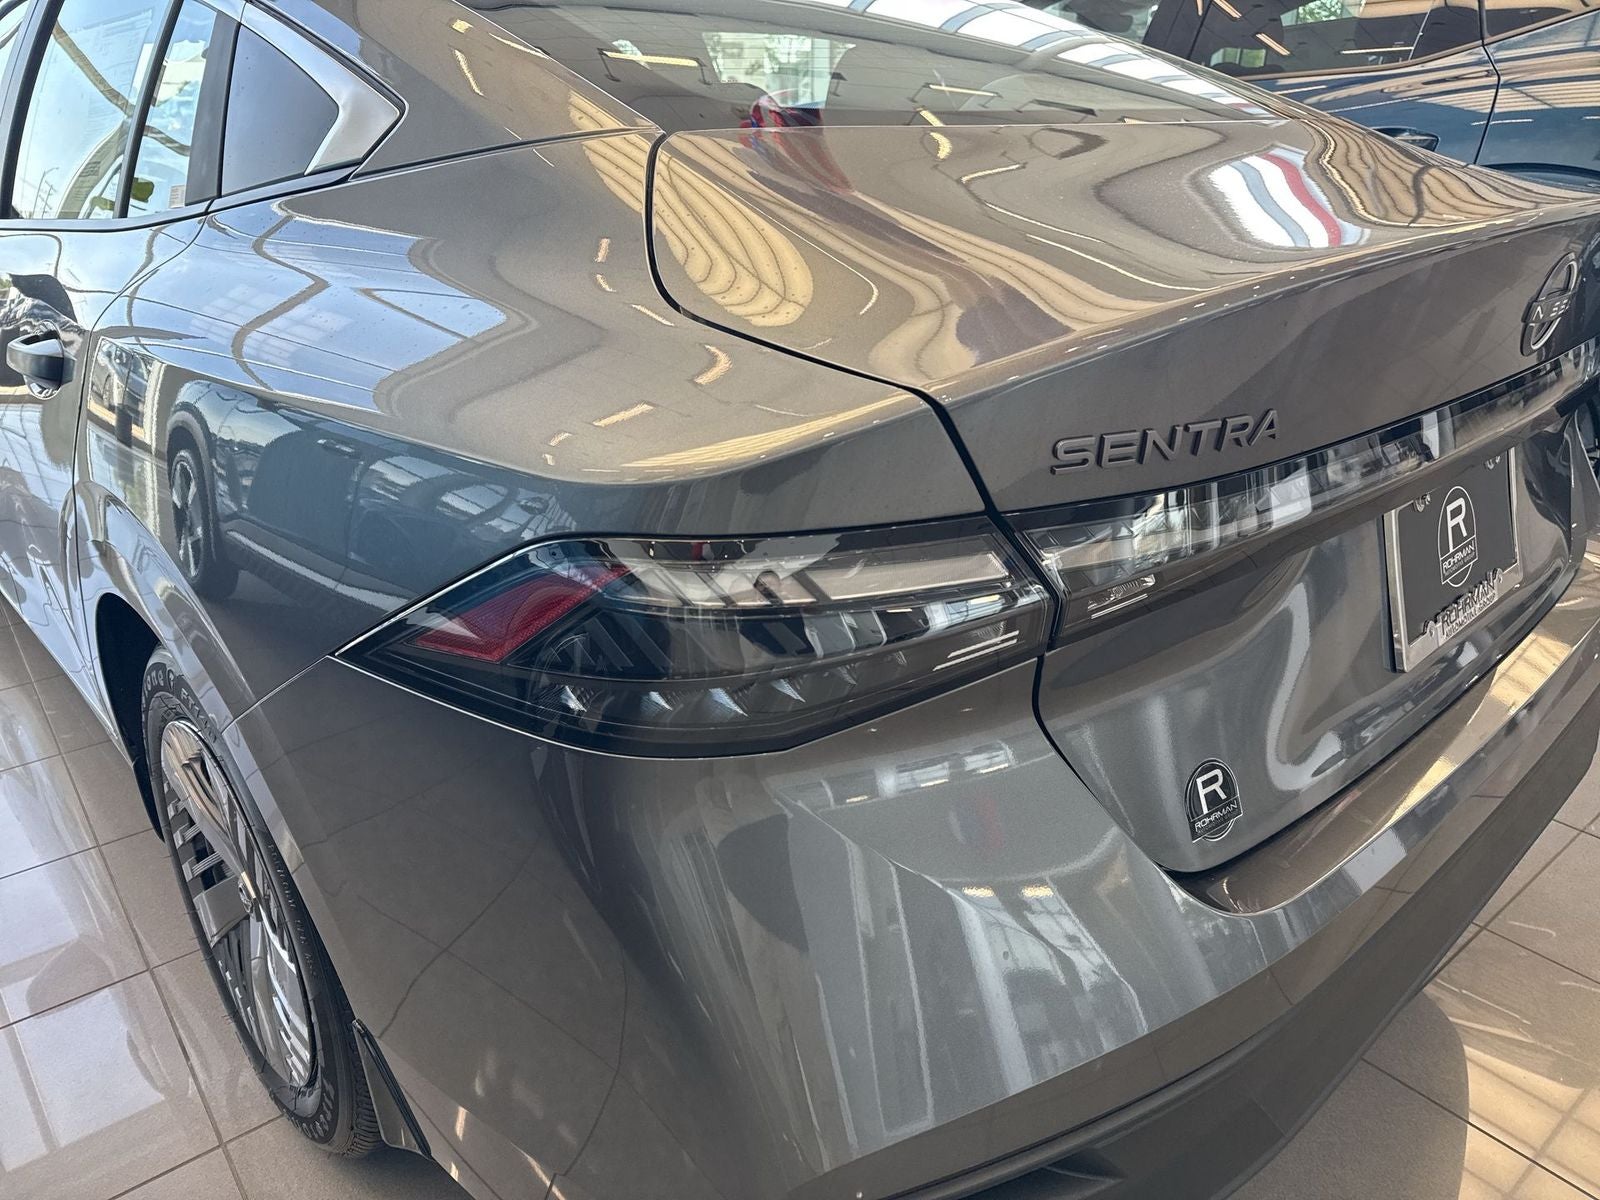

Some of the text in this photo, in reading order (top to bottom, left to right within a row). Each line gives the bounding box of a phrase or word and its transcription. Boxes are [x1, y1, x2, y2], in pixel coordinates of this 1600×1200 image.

[1050, 408, 1280, 475] SENTRA
[1446, 497, 1467, 553] R
[1442, 540, 1475, 574] ROHRMAN
[1438, 571, 1495, 636] ROHRMAN
[1194, 800, 1238, 833] ROHRMAN
[1196, 768, 1227, 814] R
